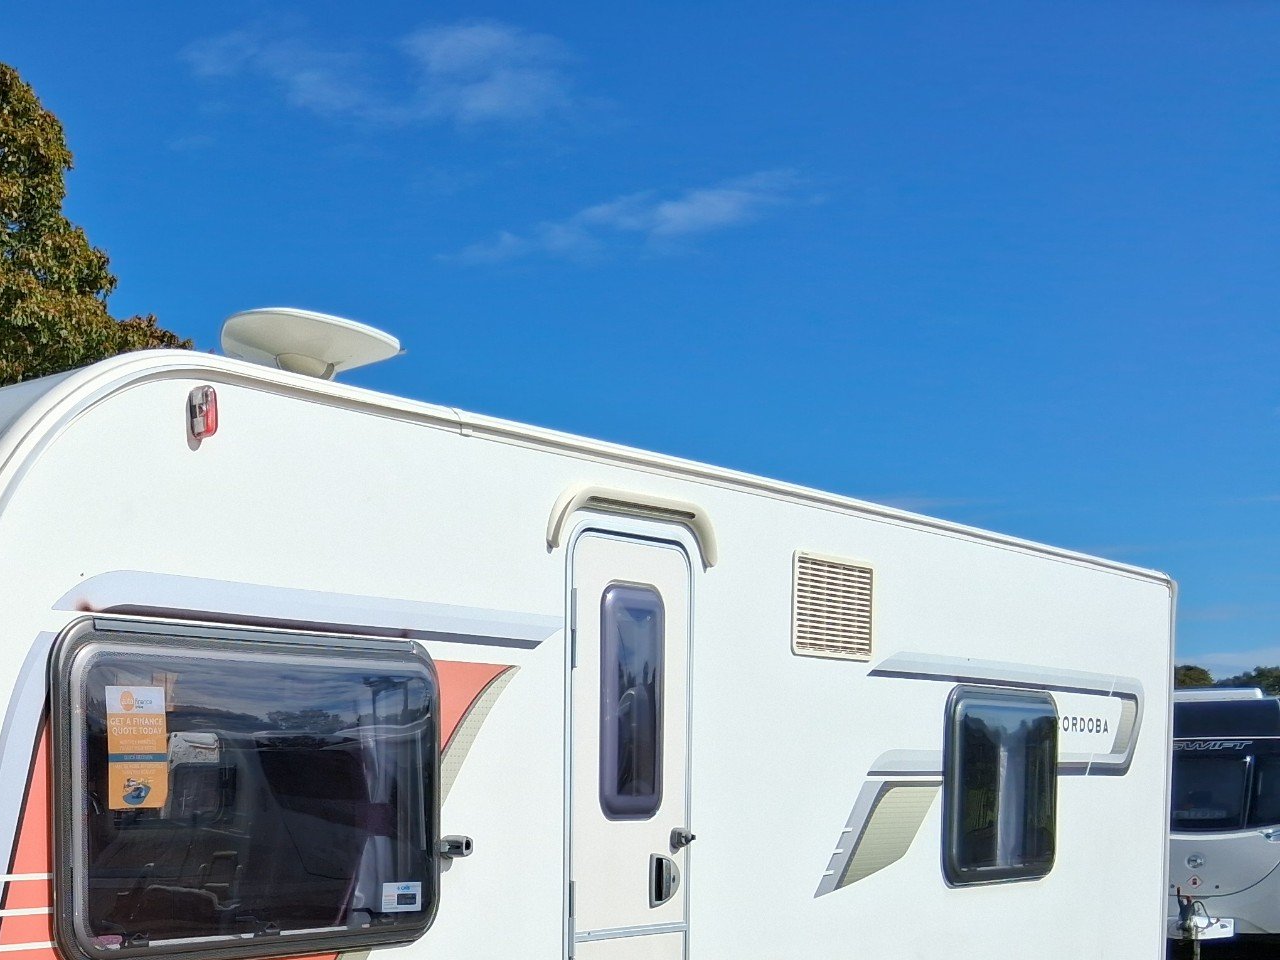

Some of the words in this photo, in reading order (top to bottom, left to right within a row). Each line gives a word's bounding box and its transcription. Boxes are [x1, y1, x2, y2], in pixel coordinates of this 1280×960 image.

[133, 718, 163, 726] FINANCE
[1059, 716, 1109, 734] ORDOBA
[112, 727, 137, 735] QUOTE
[139, 727, 162, 735] TODAY
